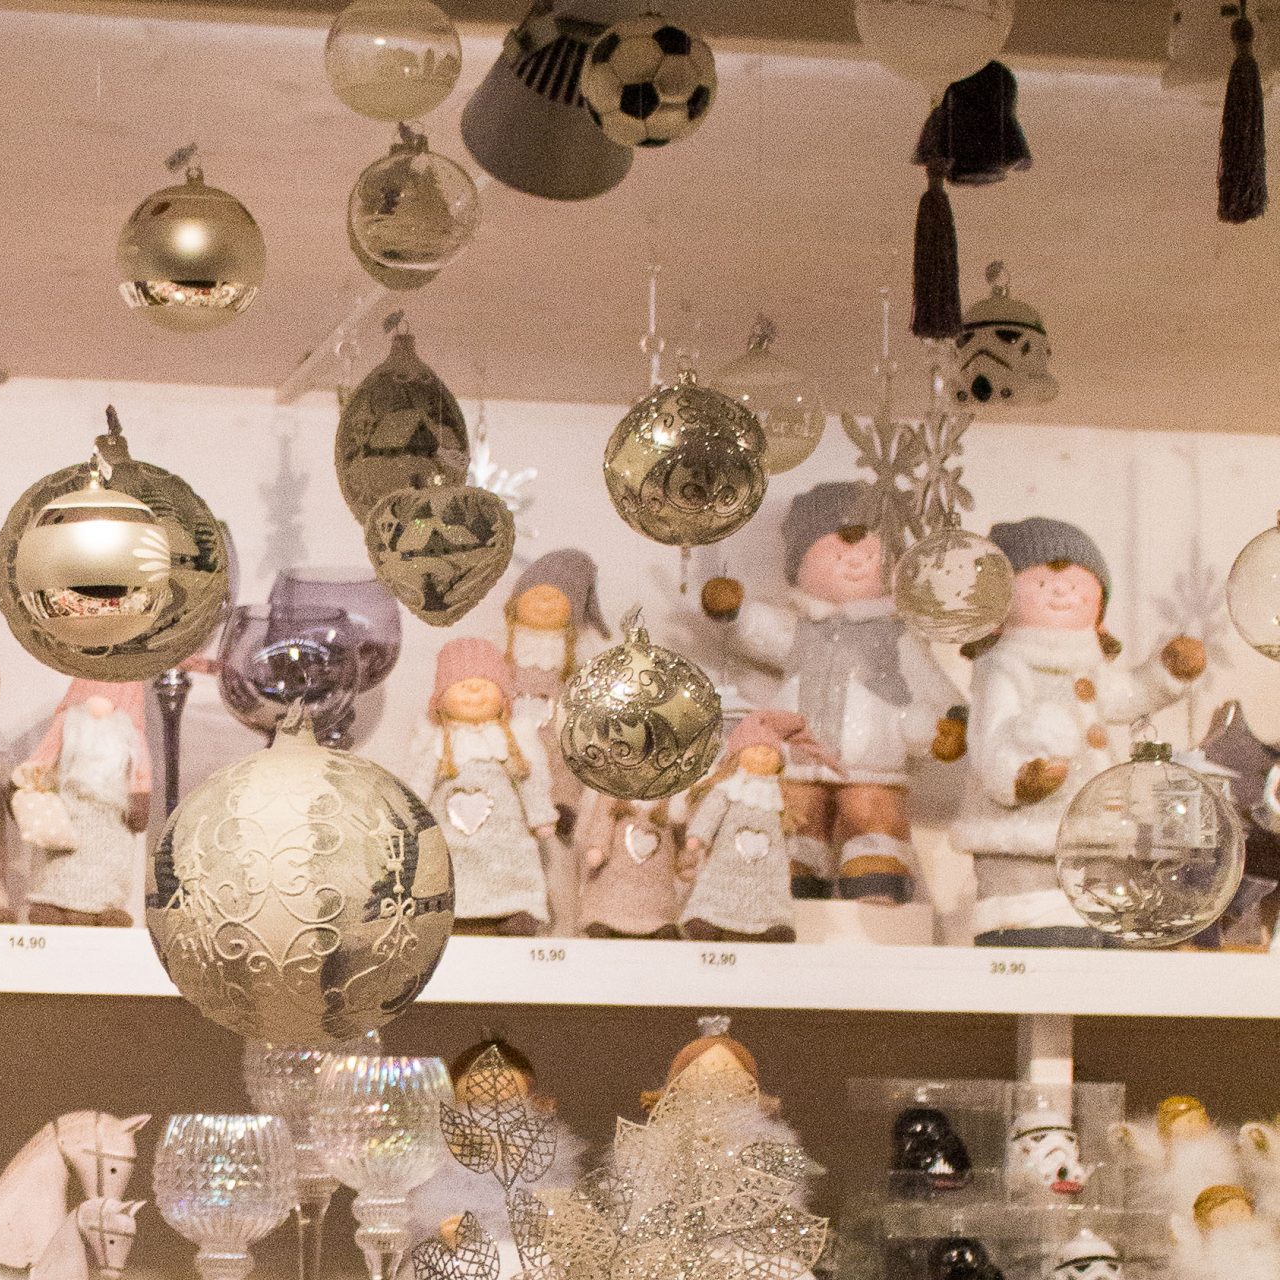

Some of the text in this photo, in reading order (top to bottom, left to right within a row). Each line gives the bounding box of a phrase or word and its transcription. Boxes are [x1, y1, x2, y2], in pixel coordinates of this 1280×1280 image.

[9, 936, 46, 950] 14,90
[530, 949, 566, 962] 15,90
[701, 952, 737, 966] 12,90
